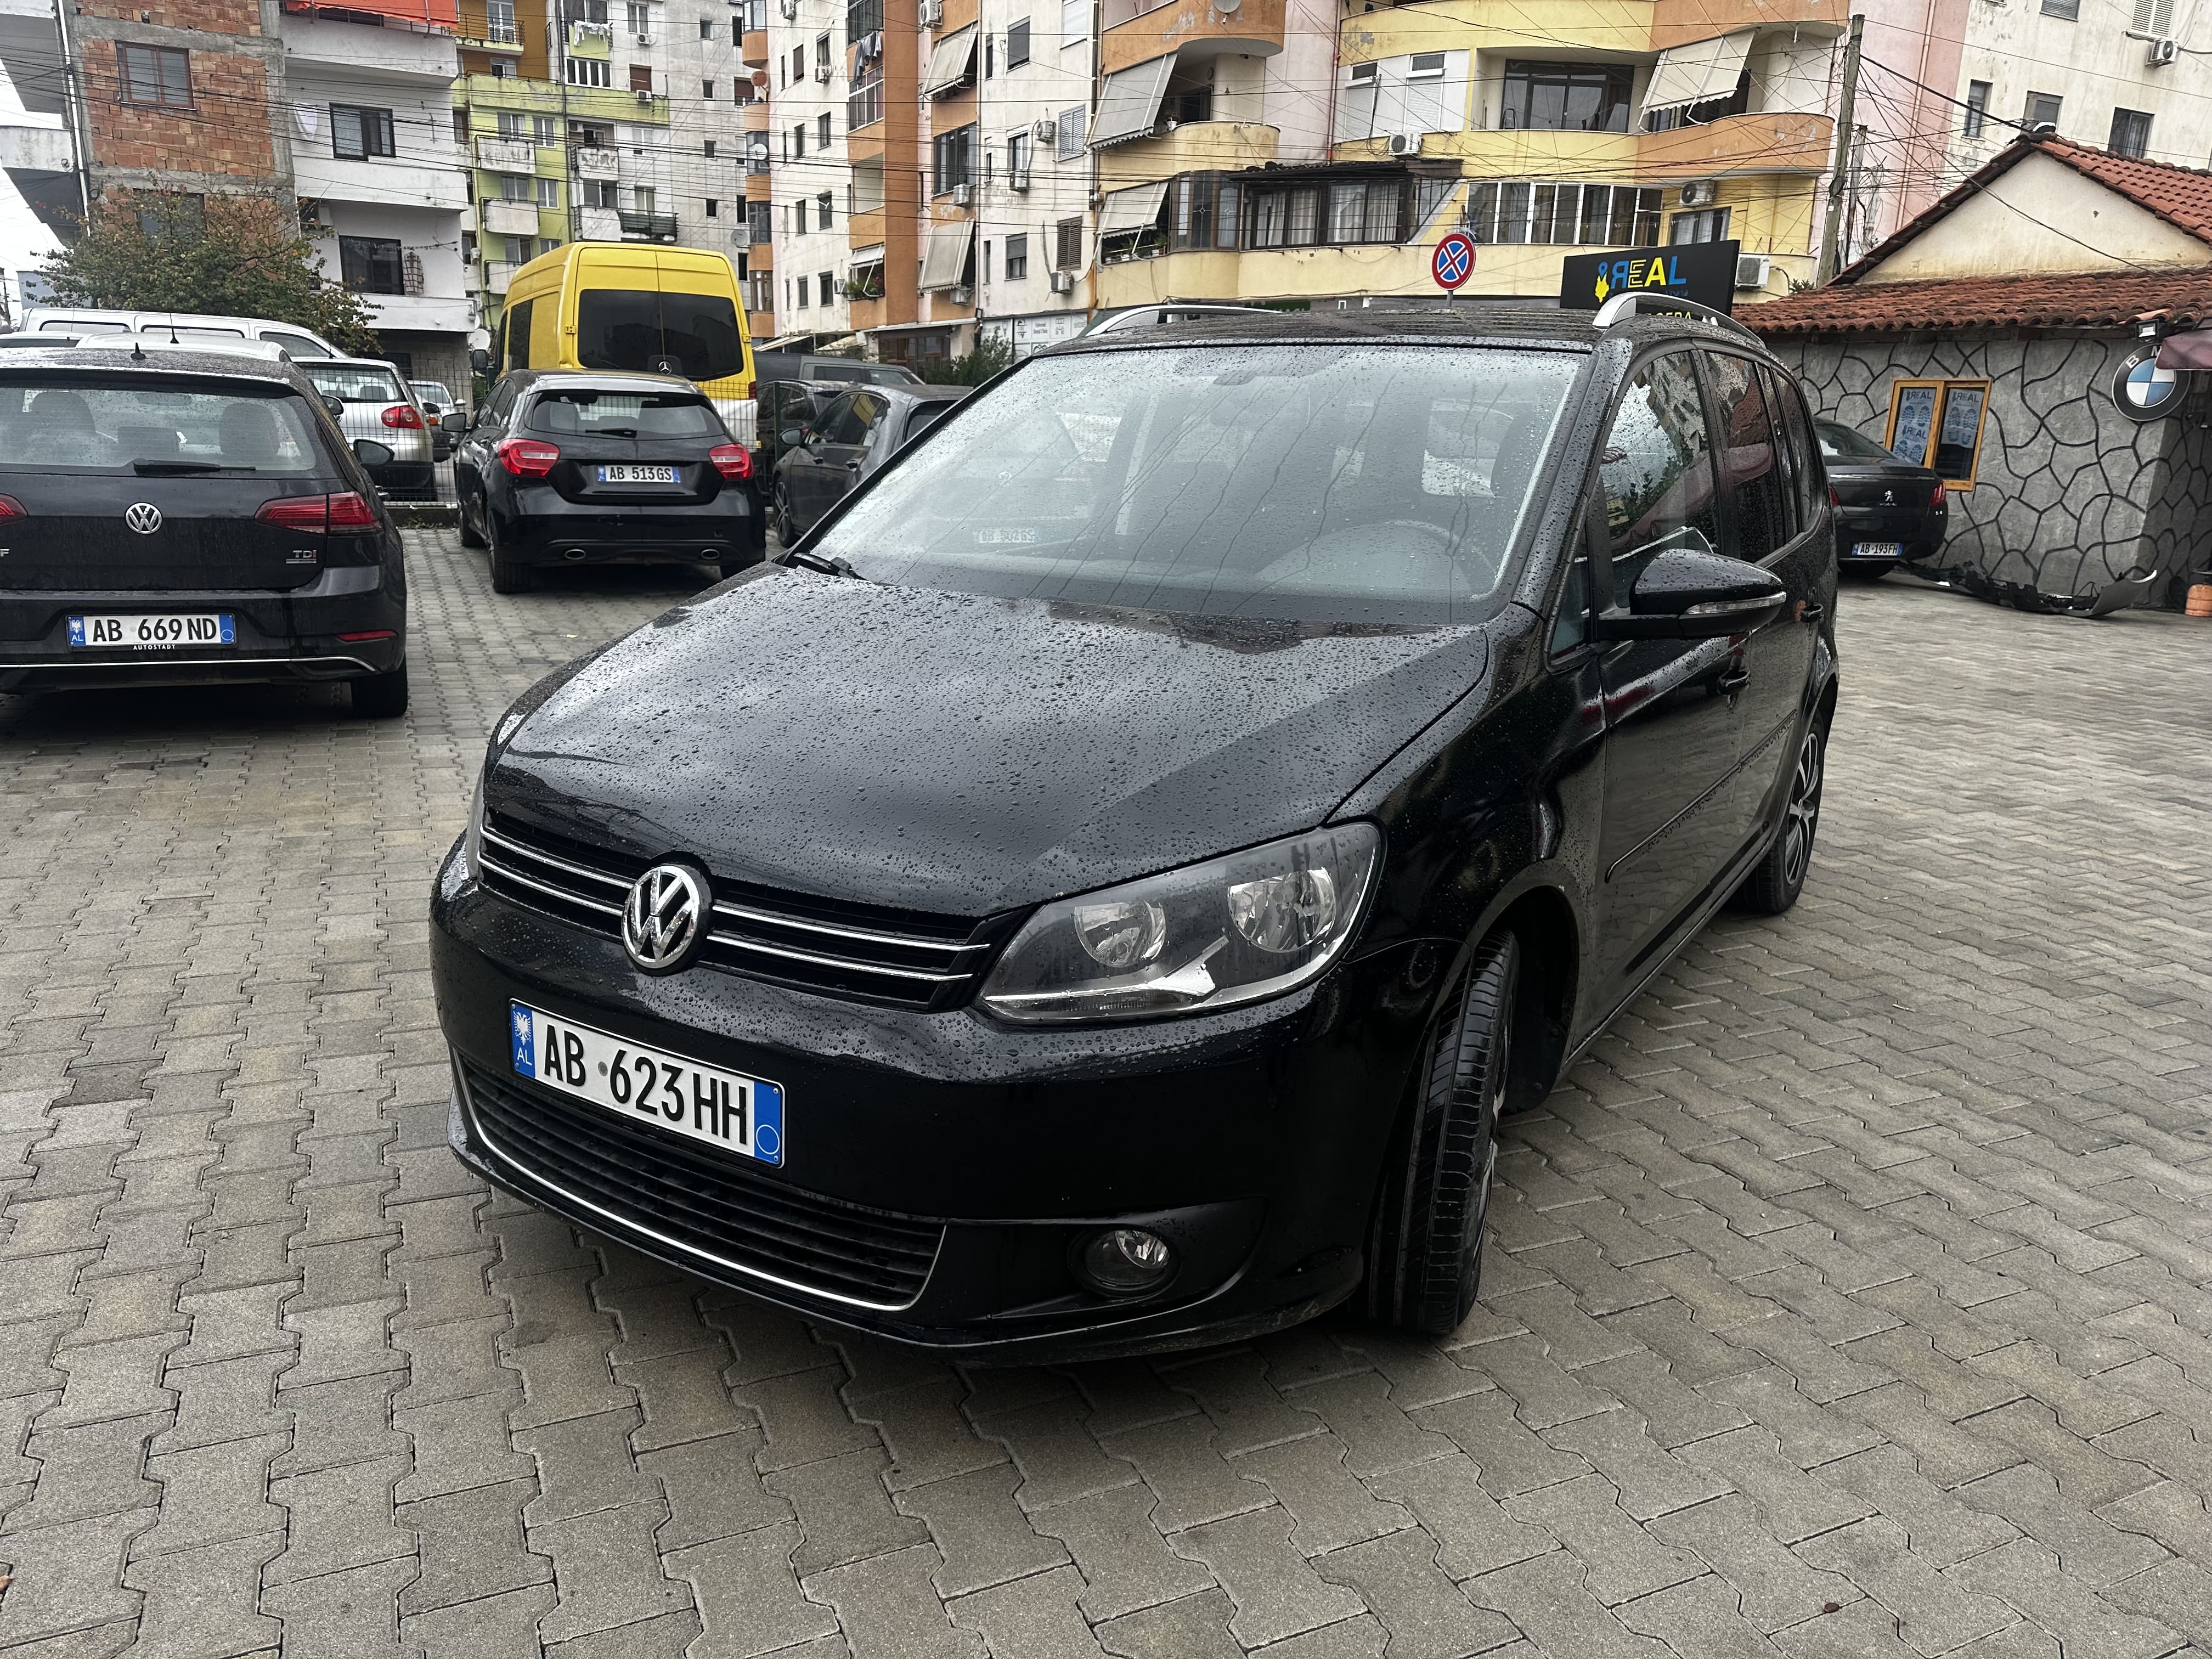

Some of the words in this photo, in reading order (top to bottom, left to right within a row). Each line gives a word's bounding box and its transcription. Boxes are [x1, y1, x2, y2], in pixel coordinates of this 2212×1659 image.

[1611, 256, 1686, 289] REAL
[610, 467, 625, 480] AB
[292, 550, 317, 558] TDI
[1860, 543, 1870, 554] AB
[92, 619, 123, 642] AB
[516, 1048, 533, 1066] AL
[544, 1023, 586, 1087] AB
